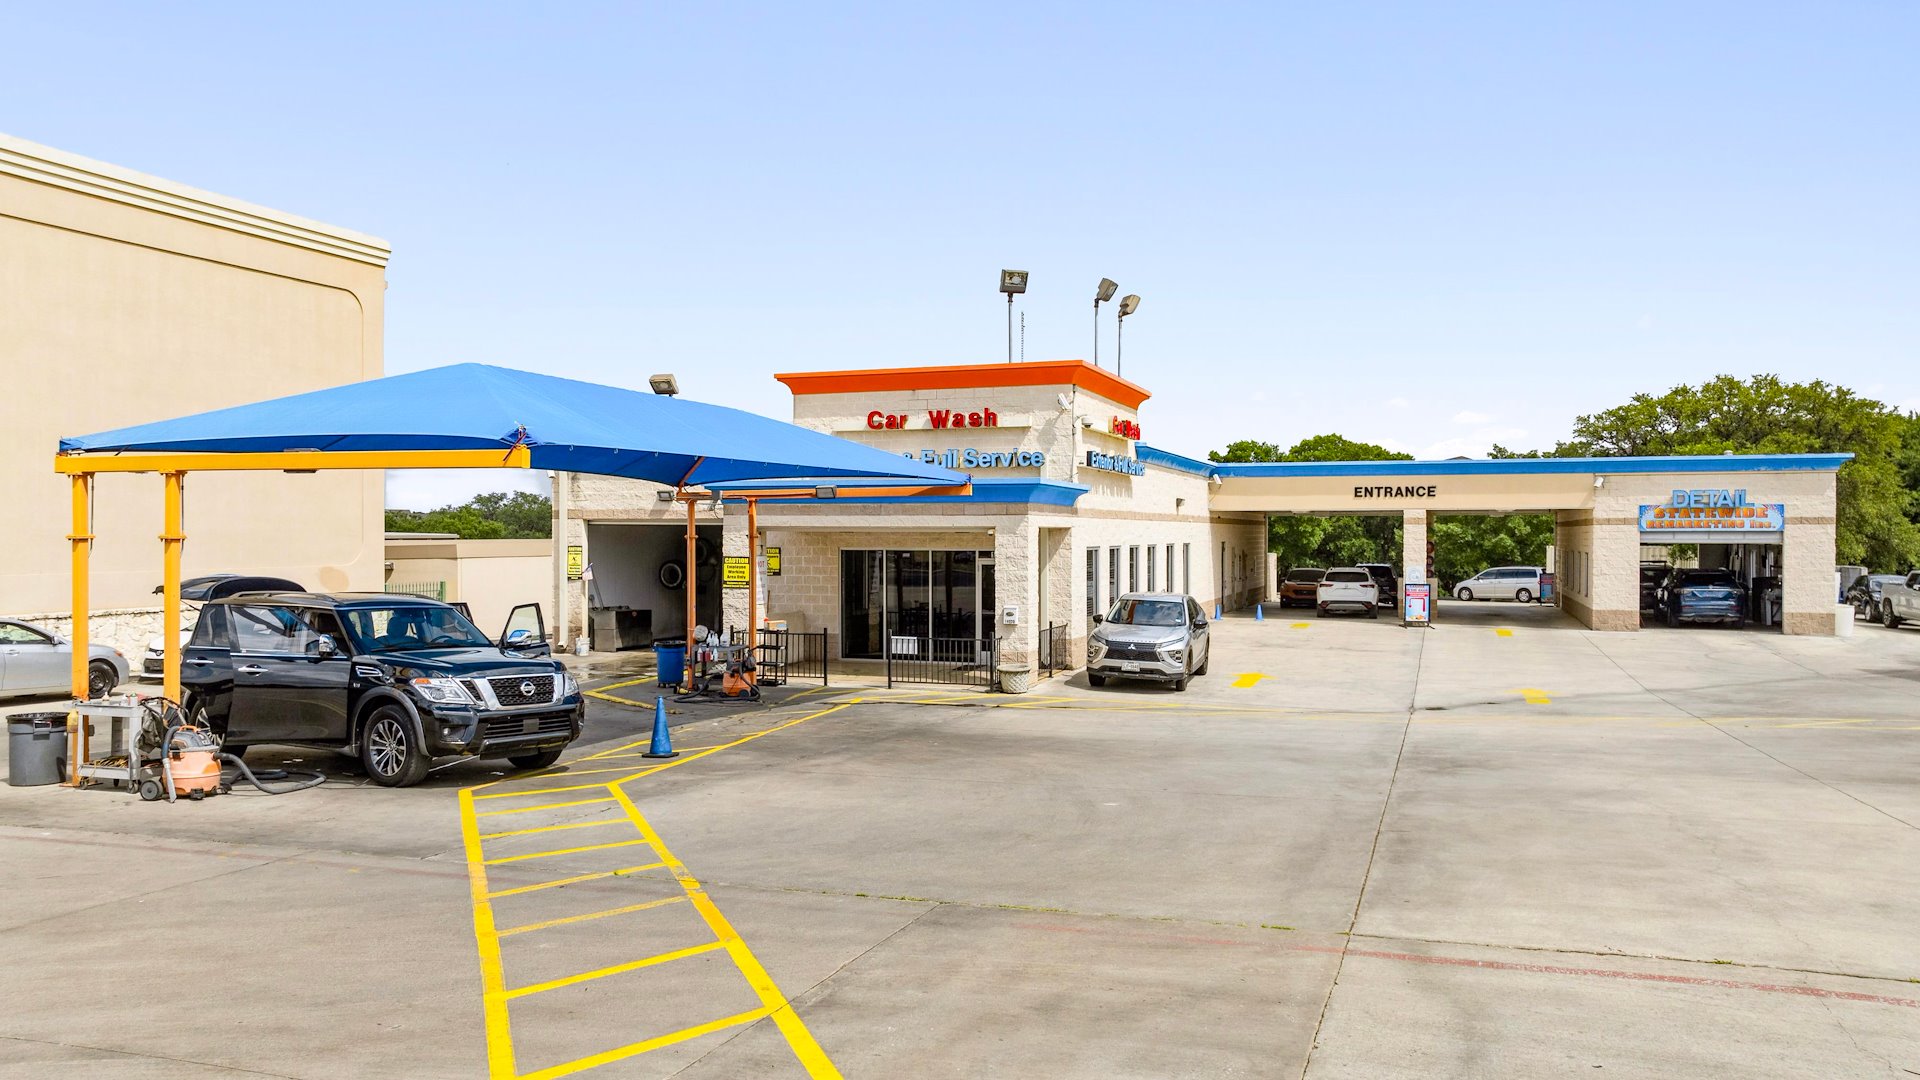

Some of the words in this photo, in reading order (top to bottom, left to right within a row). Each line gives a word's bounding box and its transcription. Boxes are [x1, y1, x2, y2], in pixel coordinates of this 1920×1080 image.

[867, 410, 908, 430] Car
[928, 407, 998, 429] Wash
[920, 448, 960, 469] Full
[963, 448, 1046, 468] Service
[1354, 485, 1437, 498] ENTRANCE
[1672, 488, 1755, 508] DETAIL
[1653, 507, 1769, 519] STATEWIDE
[1645, 519, 1745, 529] REMARKETING
